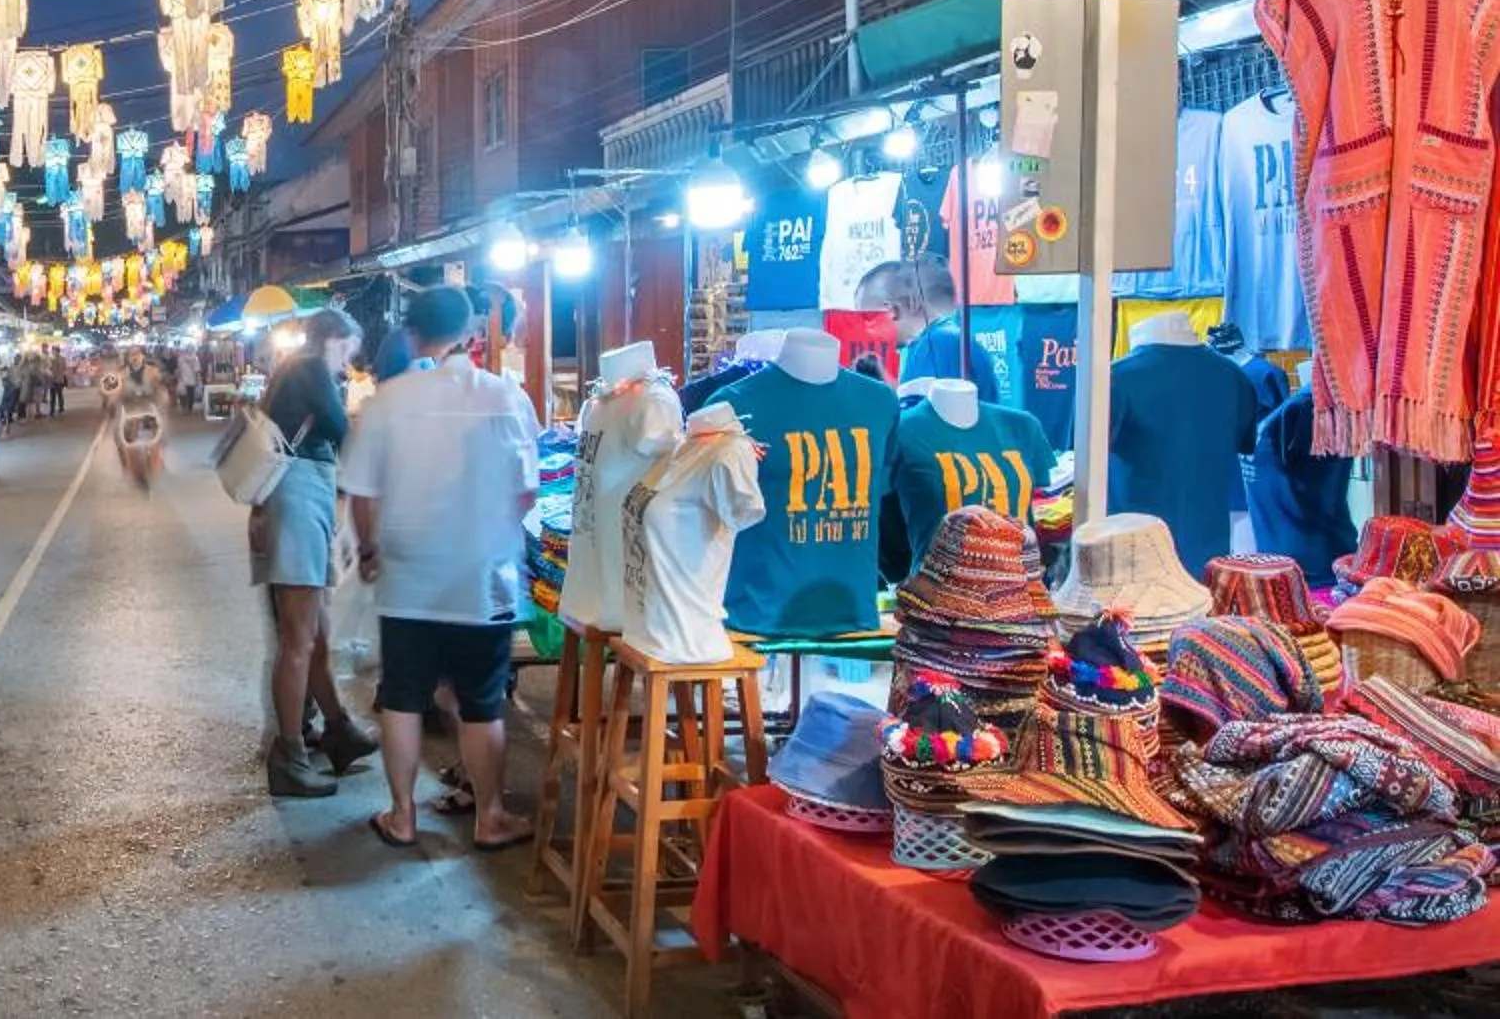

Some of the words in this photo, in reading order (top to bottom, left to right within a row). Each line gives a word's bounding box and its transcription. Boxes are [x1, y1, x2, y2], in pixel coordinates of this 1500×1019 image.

[1254, 141, 1293, 209] PA
[779, 216, 813, 243] PAI
[974, 200, 998, 229] PA
[1041, 338, 1077, 367] Pai
[784, 427, 870, 512] PAI
[935, 450, 1032, 527] PAI
